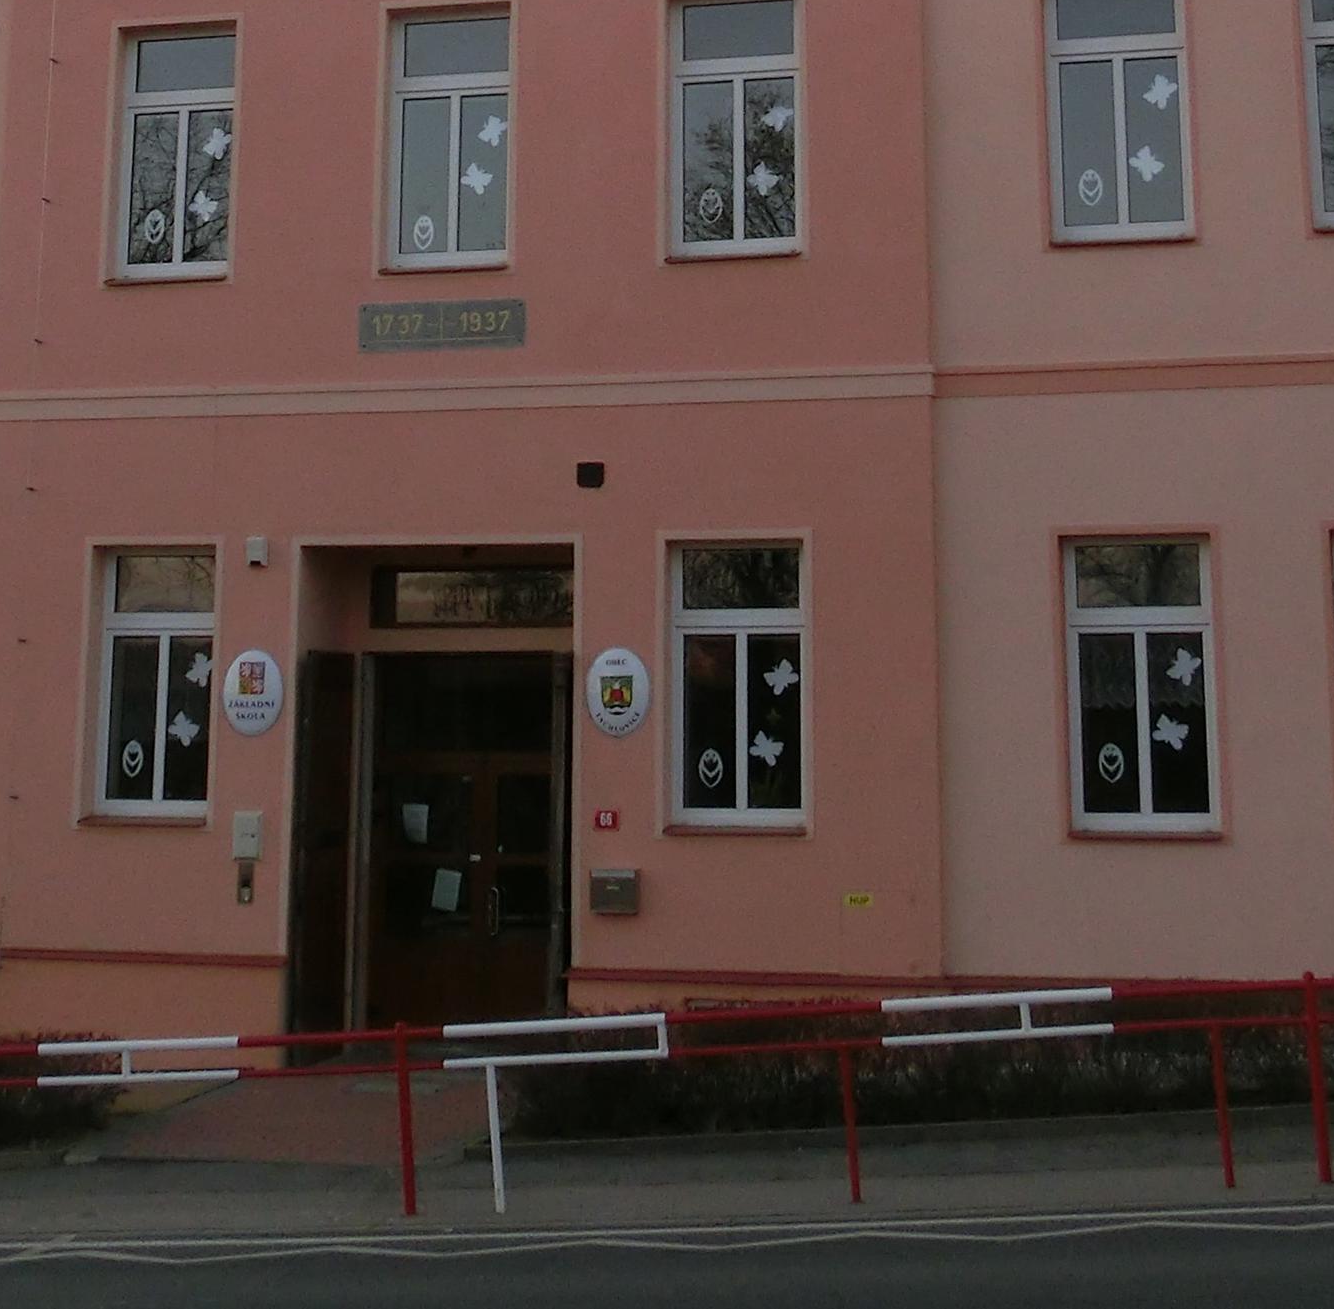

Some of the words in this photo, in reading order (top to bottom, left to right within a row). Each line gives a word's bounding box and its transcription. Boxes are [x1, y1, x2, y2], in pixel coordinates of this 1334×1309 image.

[372, 313, 424, 337] 1737
[459, 309, 510, 333] 1937
[605, 658, 627, 666] OBEC
[235, 711, 266, 720] ŠKOLA
